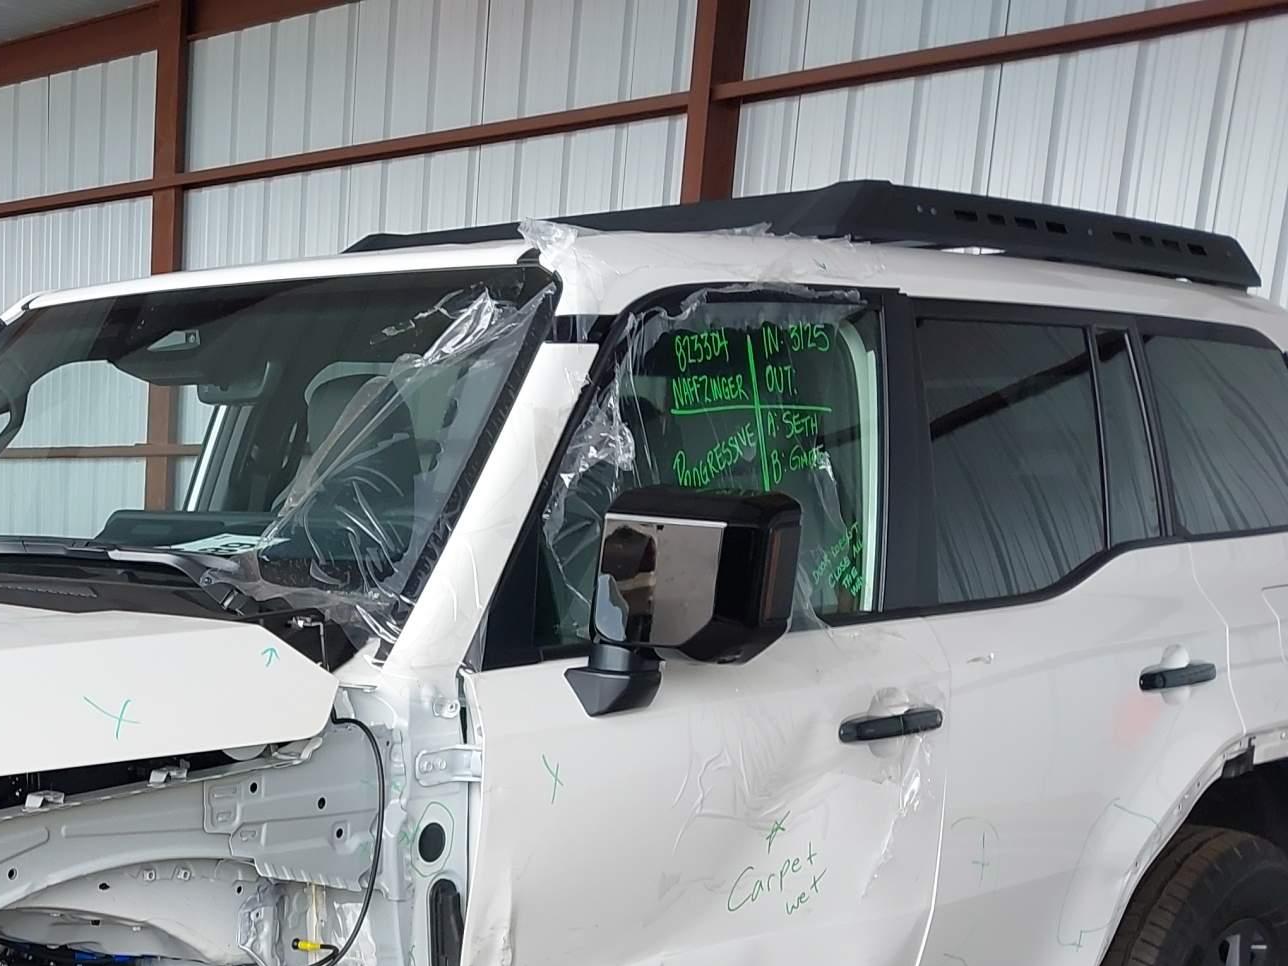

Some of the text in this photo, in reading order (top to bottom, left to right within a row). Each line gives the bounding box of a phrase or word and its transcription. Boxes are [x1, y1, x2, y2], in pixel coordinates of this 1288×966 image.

[675, 327, 729, 372] 823304
[782, 411, 819, 439] SETH
[727, 841, 817, 912] Carpet
[786, 868, 827, 915] wet
